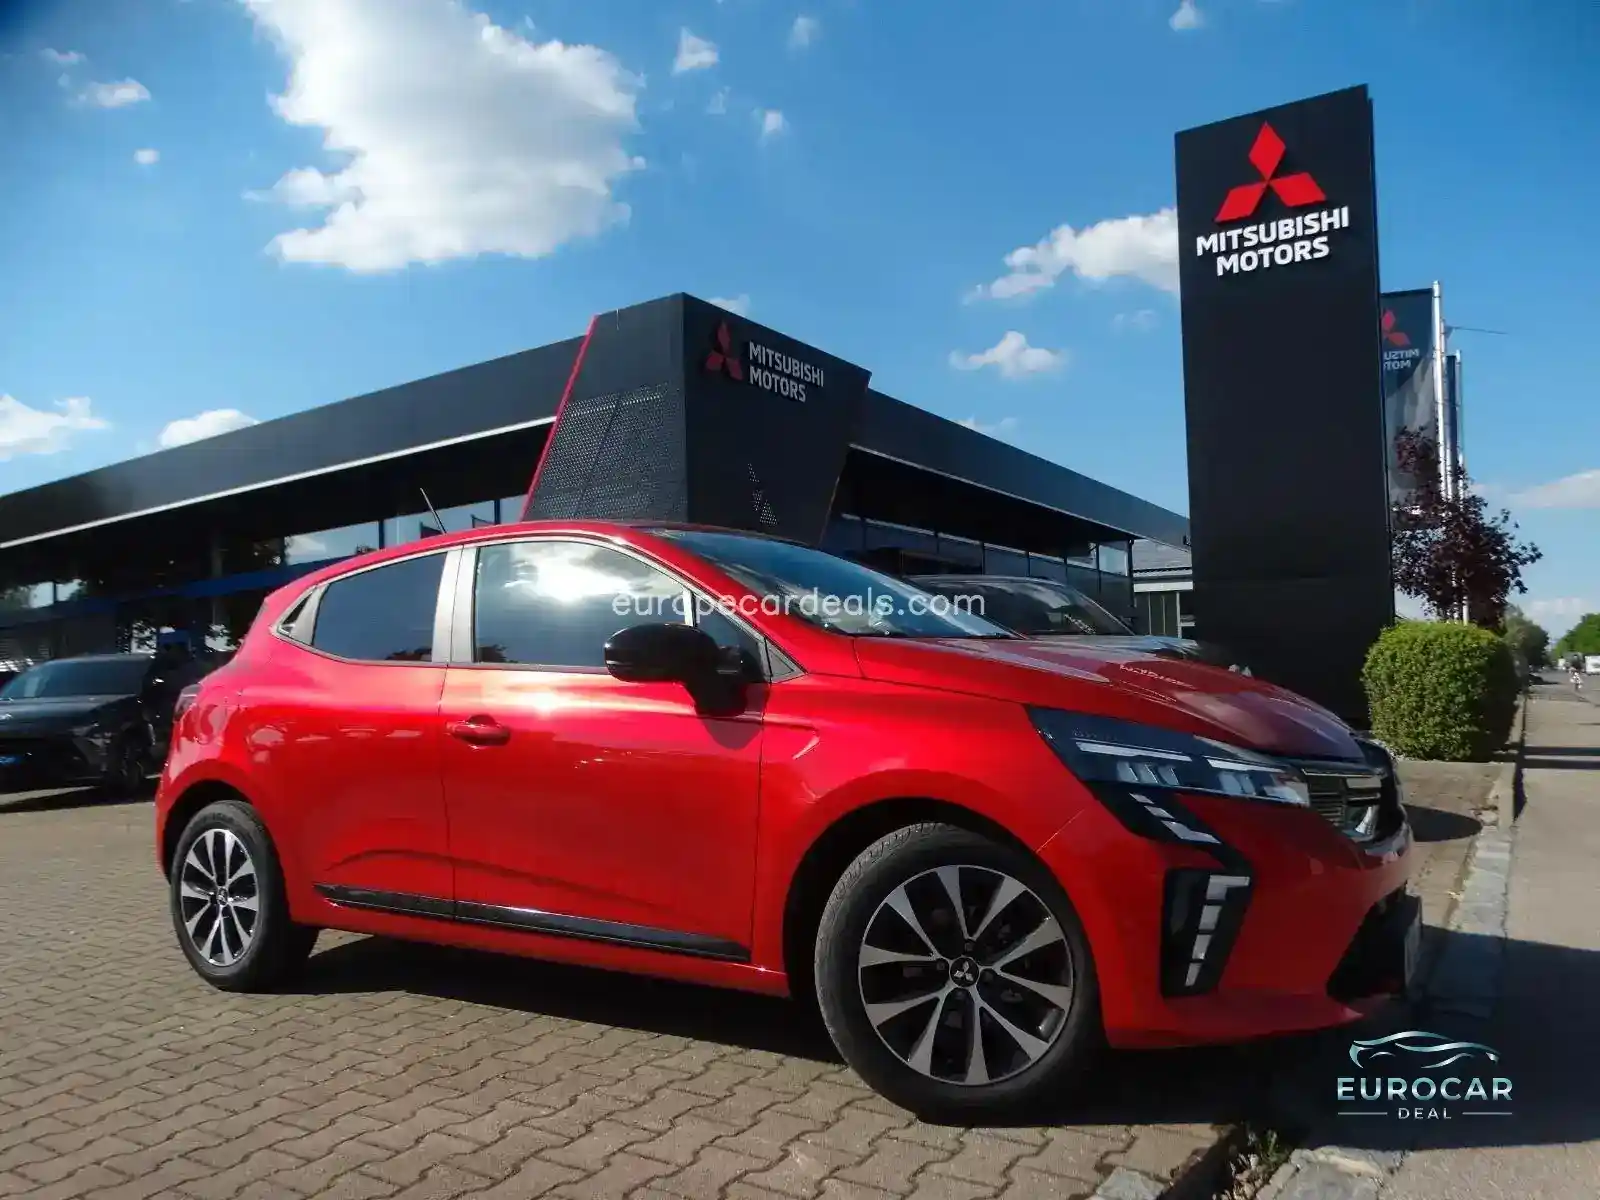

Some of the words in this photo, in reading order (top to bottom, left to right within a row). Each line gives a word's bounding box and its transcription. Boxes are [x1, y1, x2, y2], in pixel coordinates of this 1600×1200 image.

[1196, 205, 1349, 257] MITSUBISHI
[1216, 236, 1330, 277] MOTORS
[749, 340, 824, 388] MITSUBISHI
[749, 366, 806, 403] MOTORS
